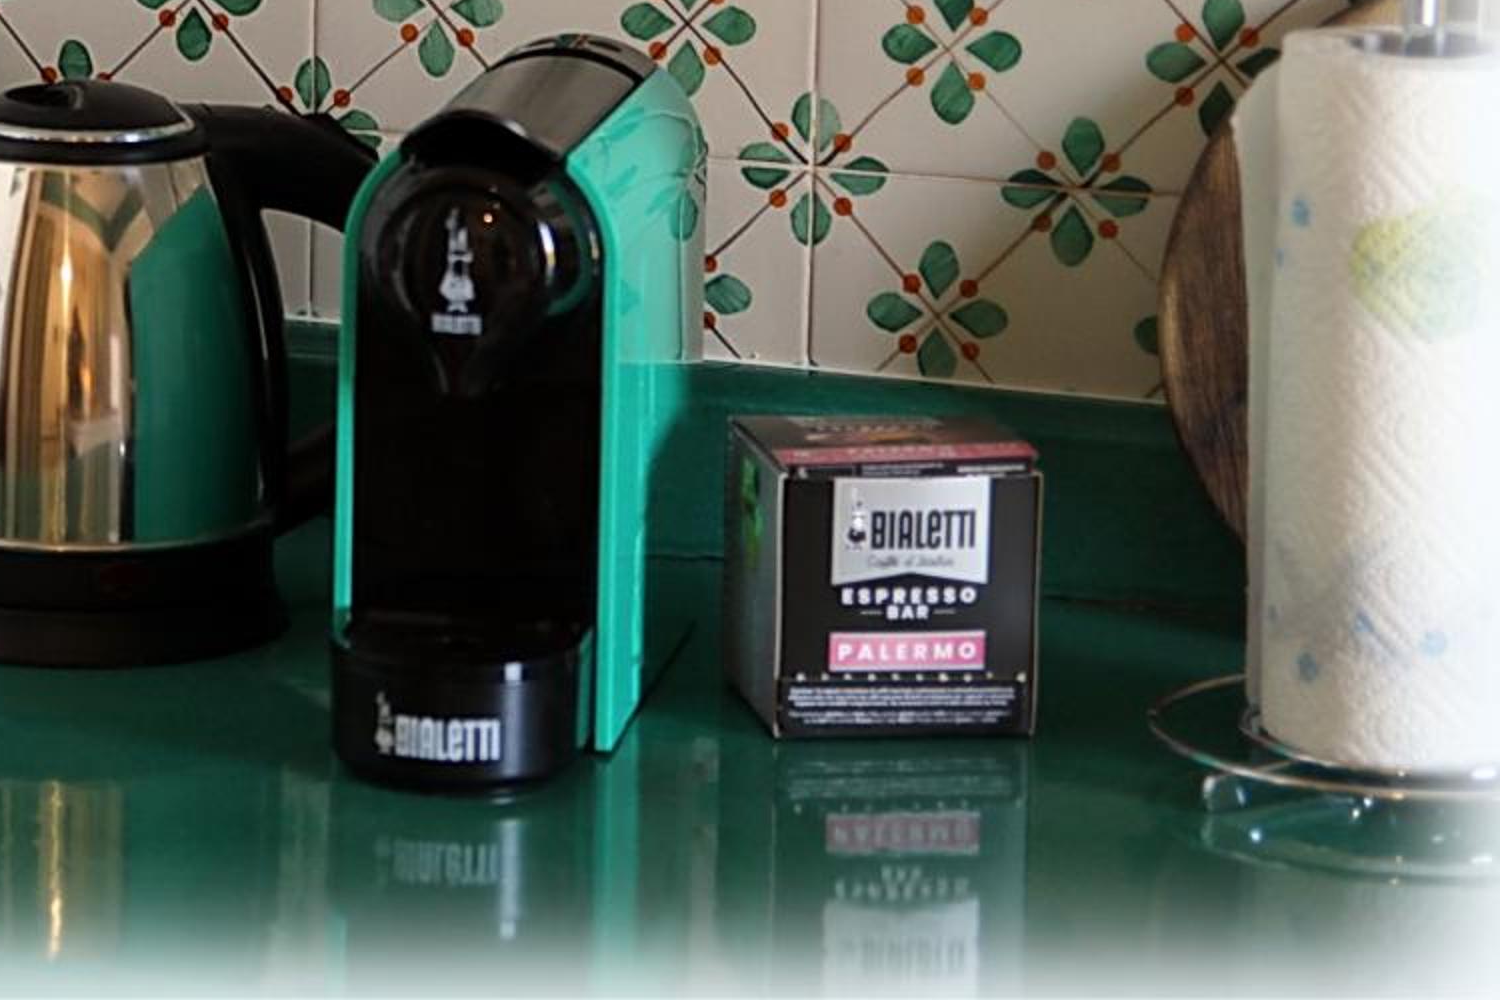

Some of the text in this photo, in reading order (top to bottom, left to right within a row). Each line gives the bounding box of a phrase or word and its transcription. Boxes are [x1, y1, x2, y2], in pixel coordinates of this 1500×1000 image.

[841, 586, 978, 606] ESPRESSO
[886, 604, 930, 620] BAR
[837, 641, 978, 662] PALERMO
